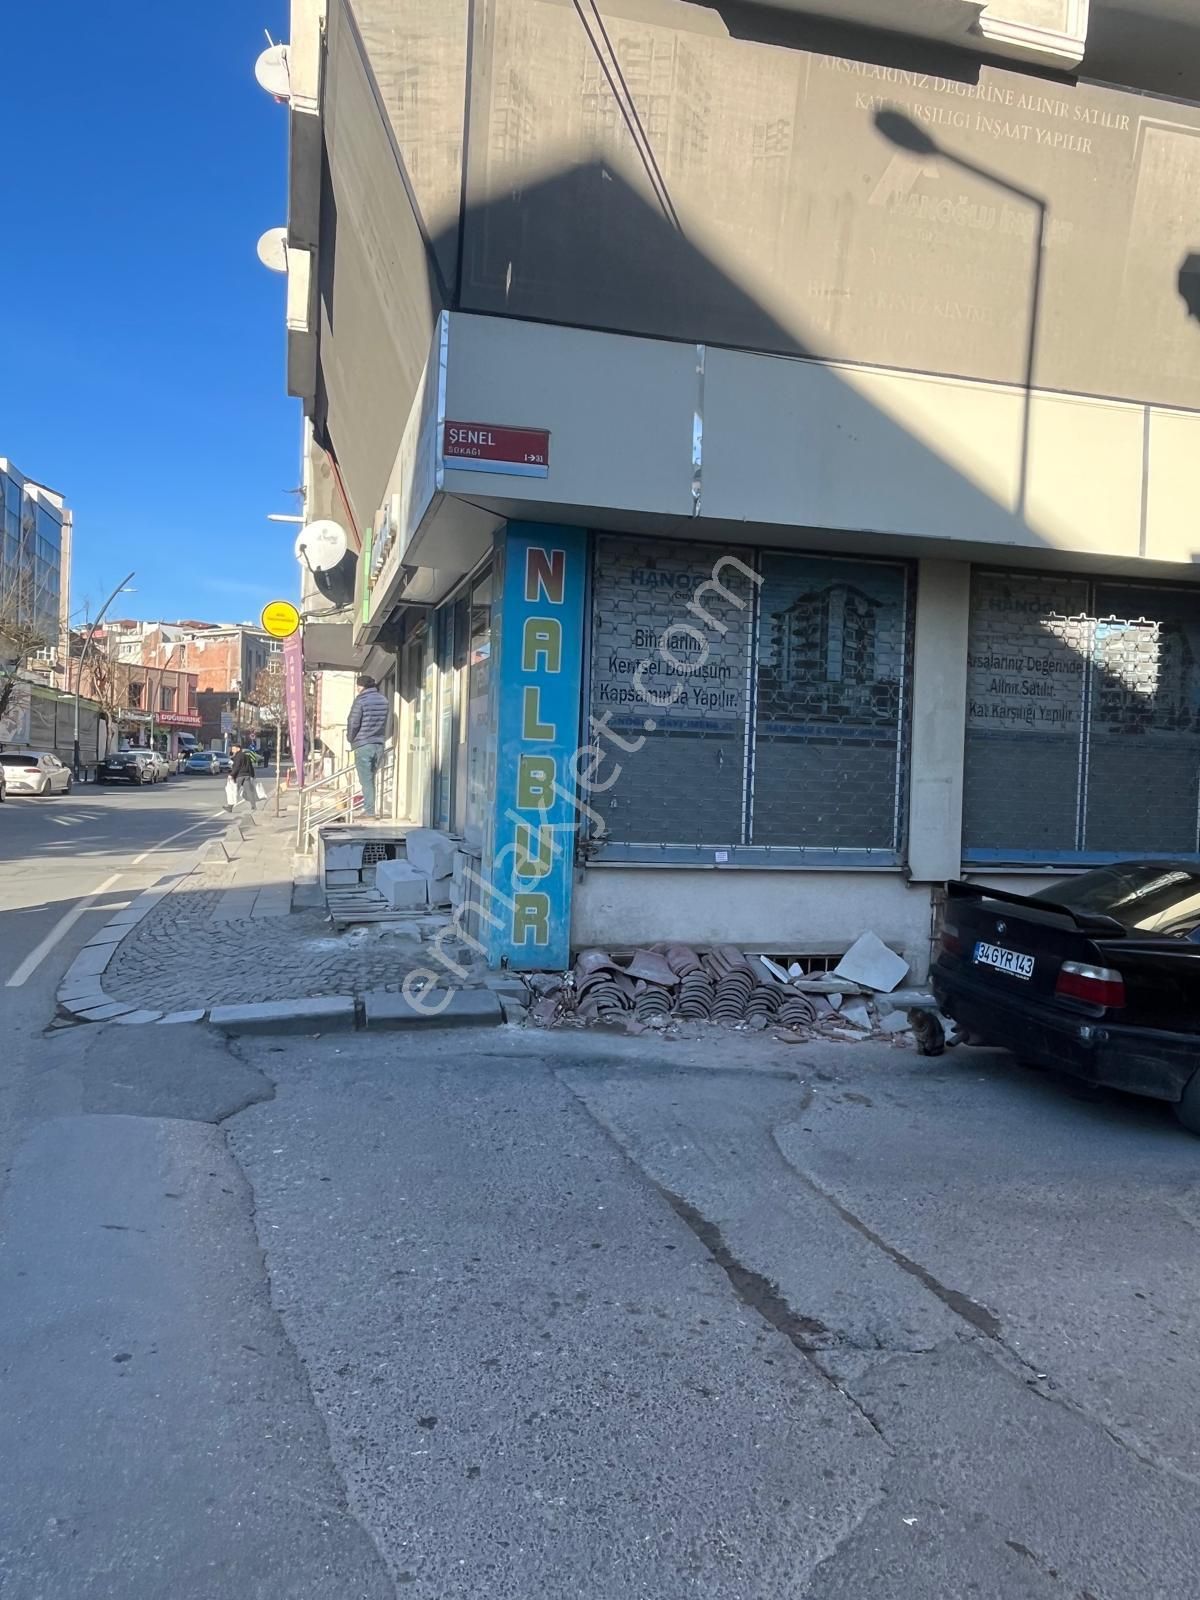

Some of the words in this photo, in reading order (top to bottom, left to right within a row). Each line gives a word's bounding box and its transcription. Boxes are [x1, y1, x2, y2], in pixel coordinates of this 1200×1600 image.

[1017, 92, 1069, 118] ALINIR
[1073, 104, 1130, 131] SATILIR
[975, 112, 1032, 140] İNŞAAT
[1035, 128, 1092, 154] YAPILIR
[449, 428, 496, 446] ŞENEL
[535, 455, 544, 463] 31
[511, 547, 566, 945] NALBUR
[978, 944, 990, 961] 34
[991, 948, 1014, 969] GYR
[1015, 955, 1033, 974] 143
